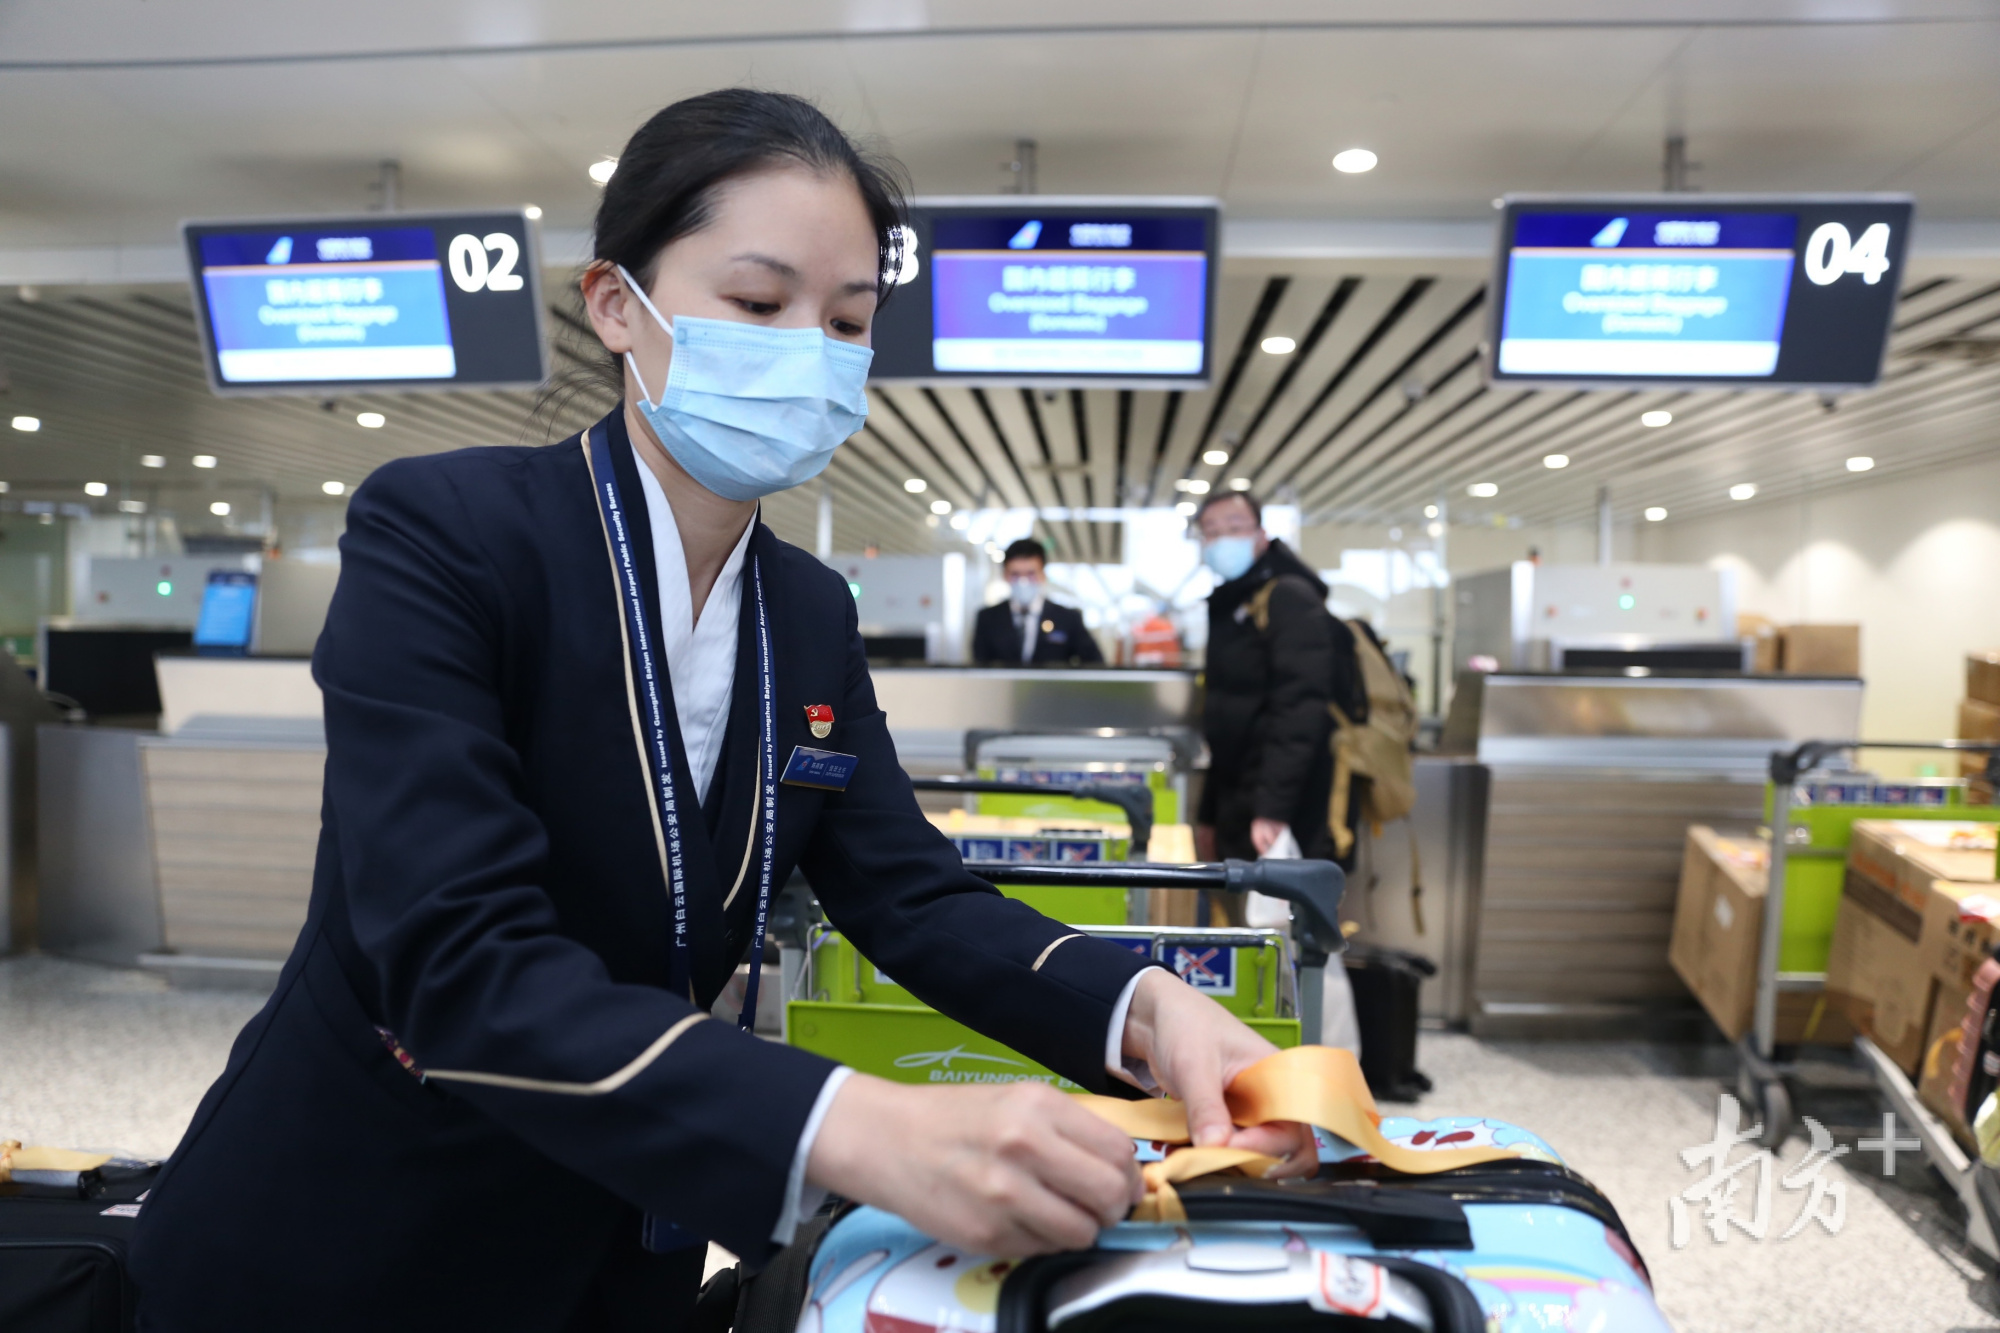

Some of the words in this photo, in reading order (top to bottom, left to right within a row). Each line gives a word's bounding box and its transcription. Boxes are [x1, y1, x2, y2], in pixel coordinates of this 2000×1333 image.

[448, 232, 524, 293] 02
[1804, 221, 1891, 286] 04
[605, 482, 618, 510] Bureau
[612, 510, 625, 542] Security
[620, 543, 632, 568] Public
[625, 568, 638, 597] Airport
[631, 598, 649, 650] International
[641, 651, 653, 680] Baiyun
[760, 627, 769, 673] International
[649, 681, 661, 727] Guangzhou
[656, 728, 664, 740] by
[766, 743, 773, 753] by
[656, 740, 668, 768] Issued
[660, 772, 687, 947] 广州白云国际机场公安局制发
[755, 783, 775, 948] 广州白云国际机场公安局制发
